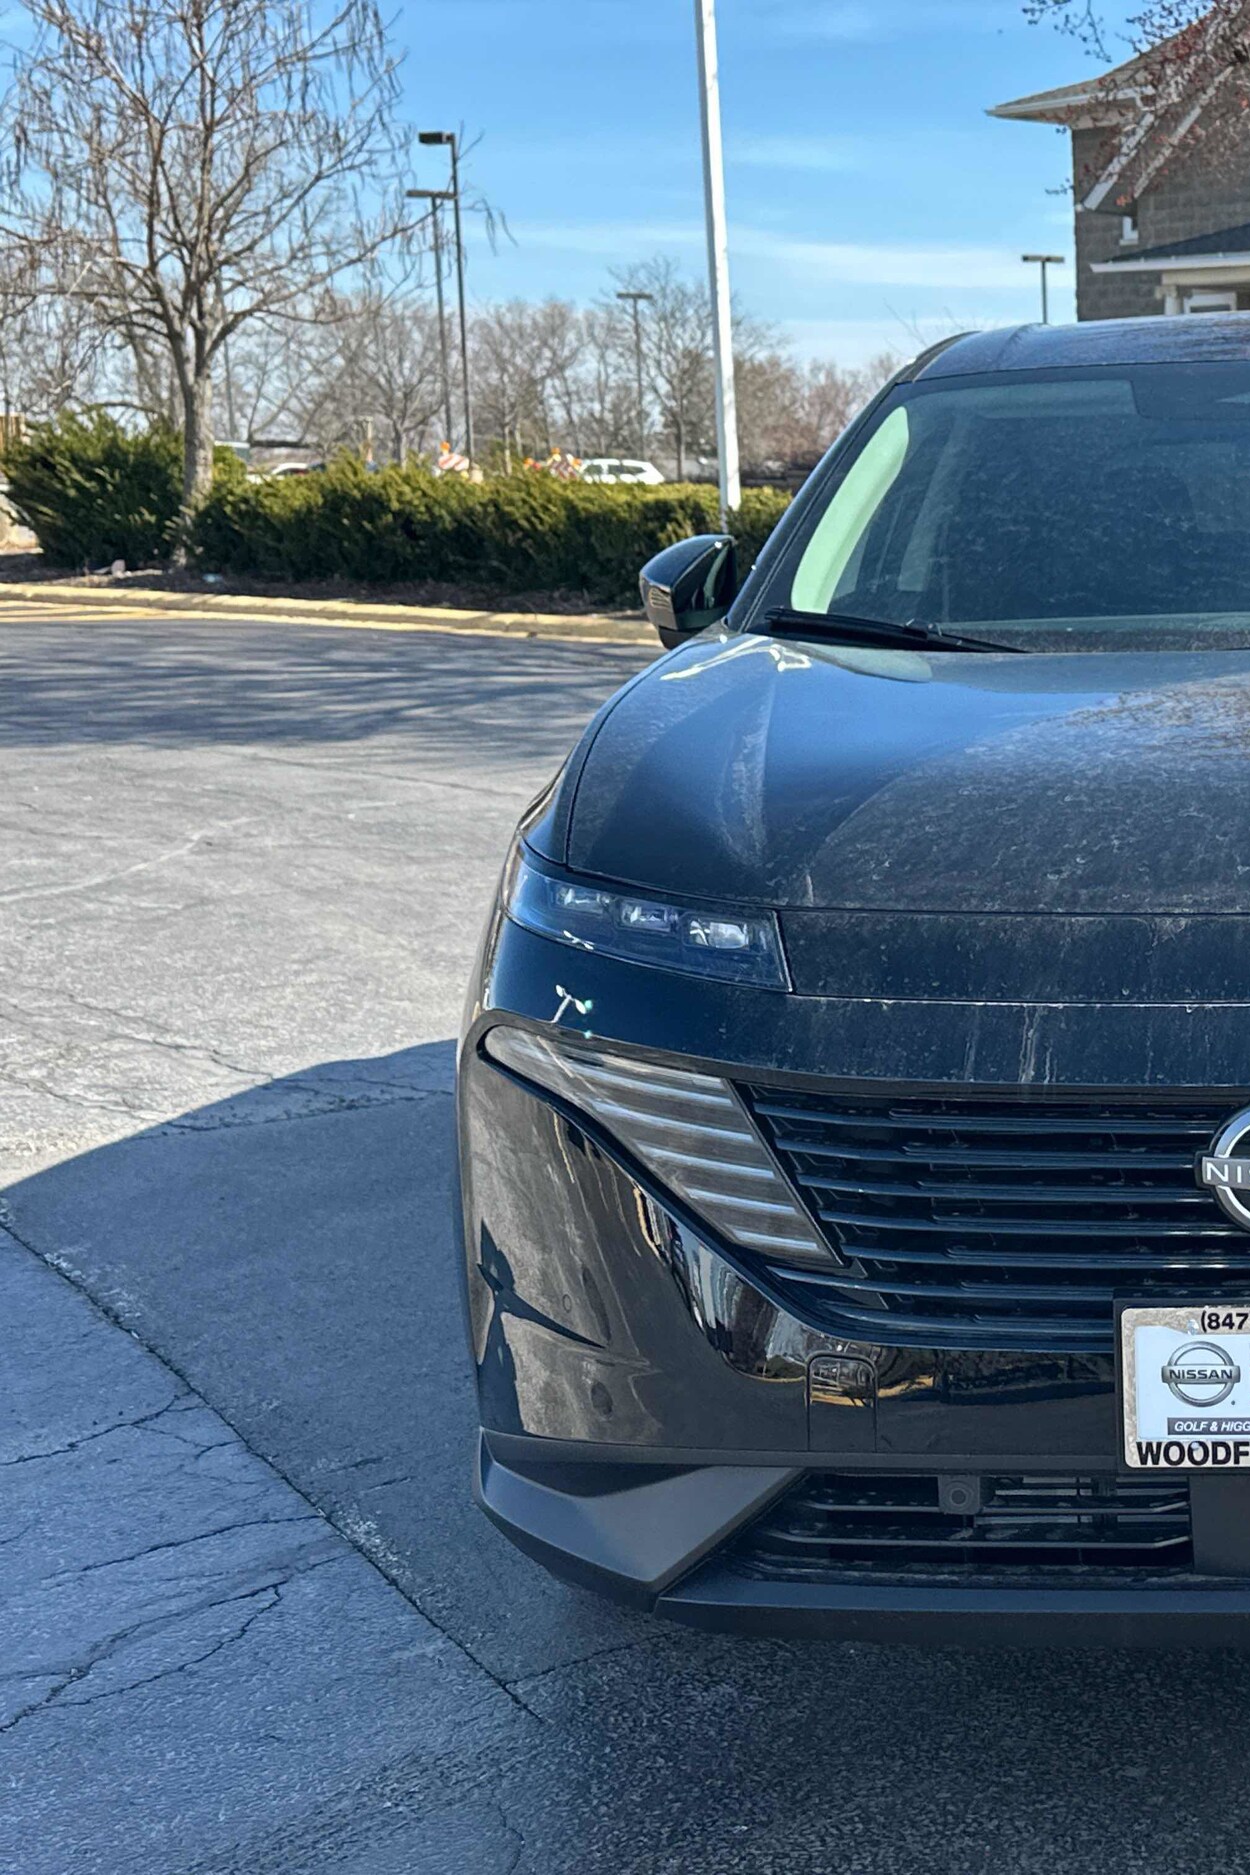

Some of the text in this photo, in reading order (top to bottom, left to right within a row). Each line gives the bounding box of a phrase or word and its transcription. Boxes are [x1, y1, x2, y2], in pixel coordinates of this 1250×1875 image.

[1168, 1369, 1233, 1381] NISSAN
[1174, 1420, 1208, 1432] GOLF
[1209, 1420, 1218, 1432] &
